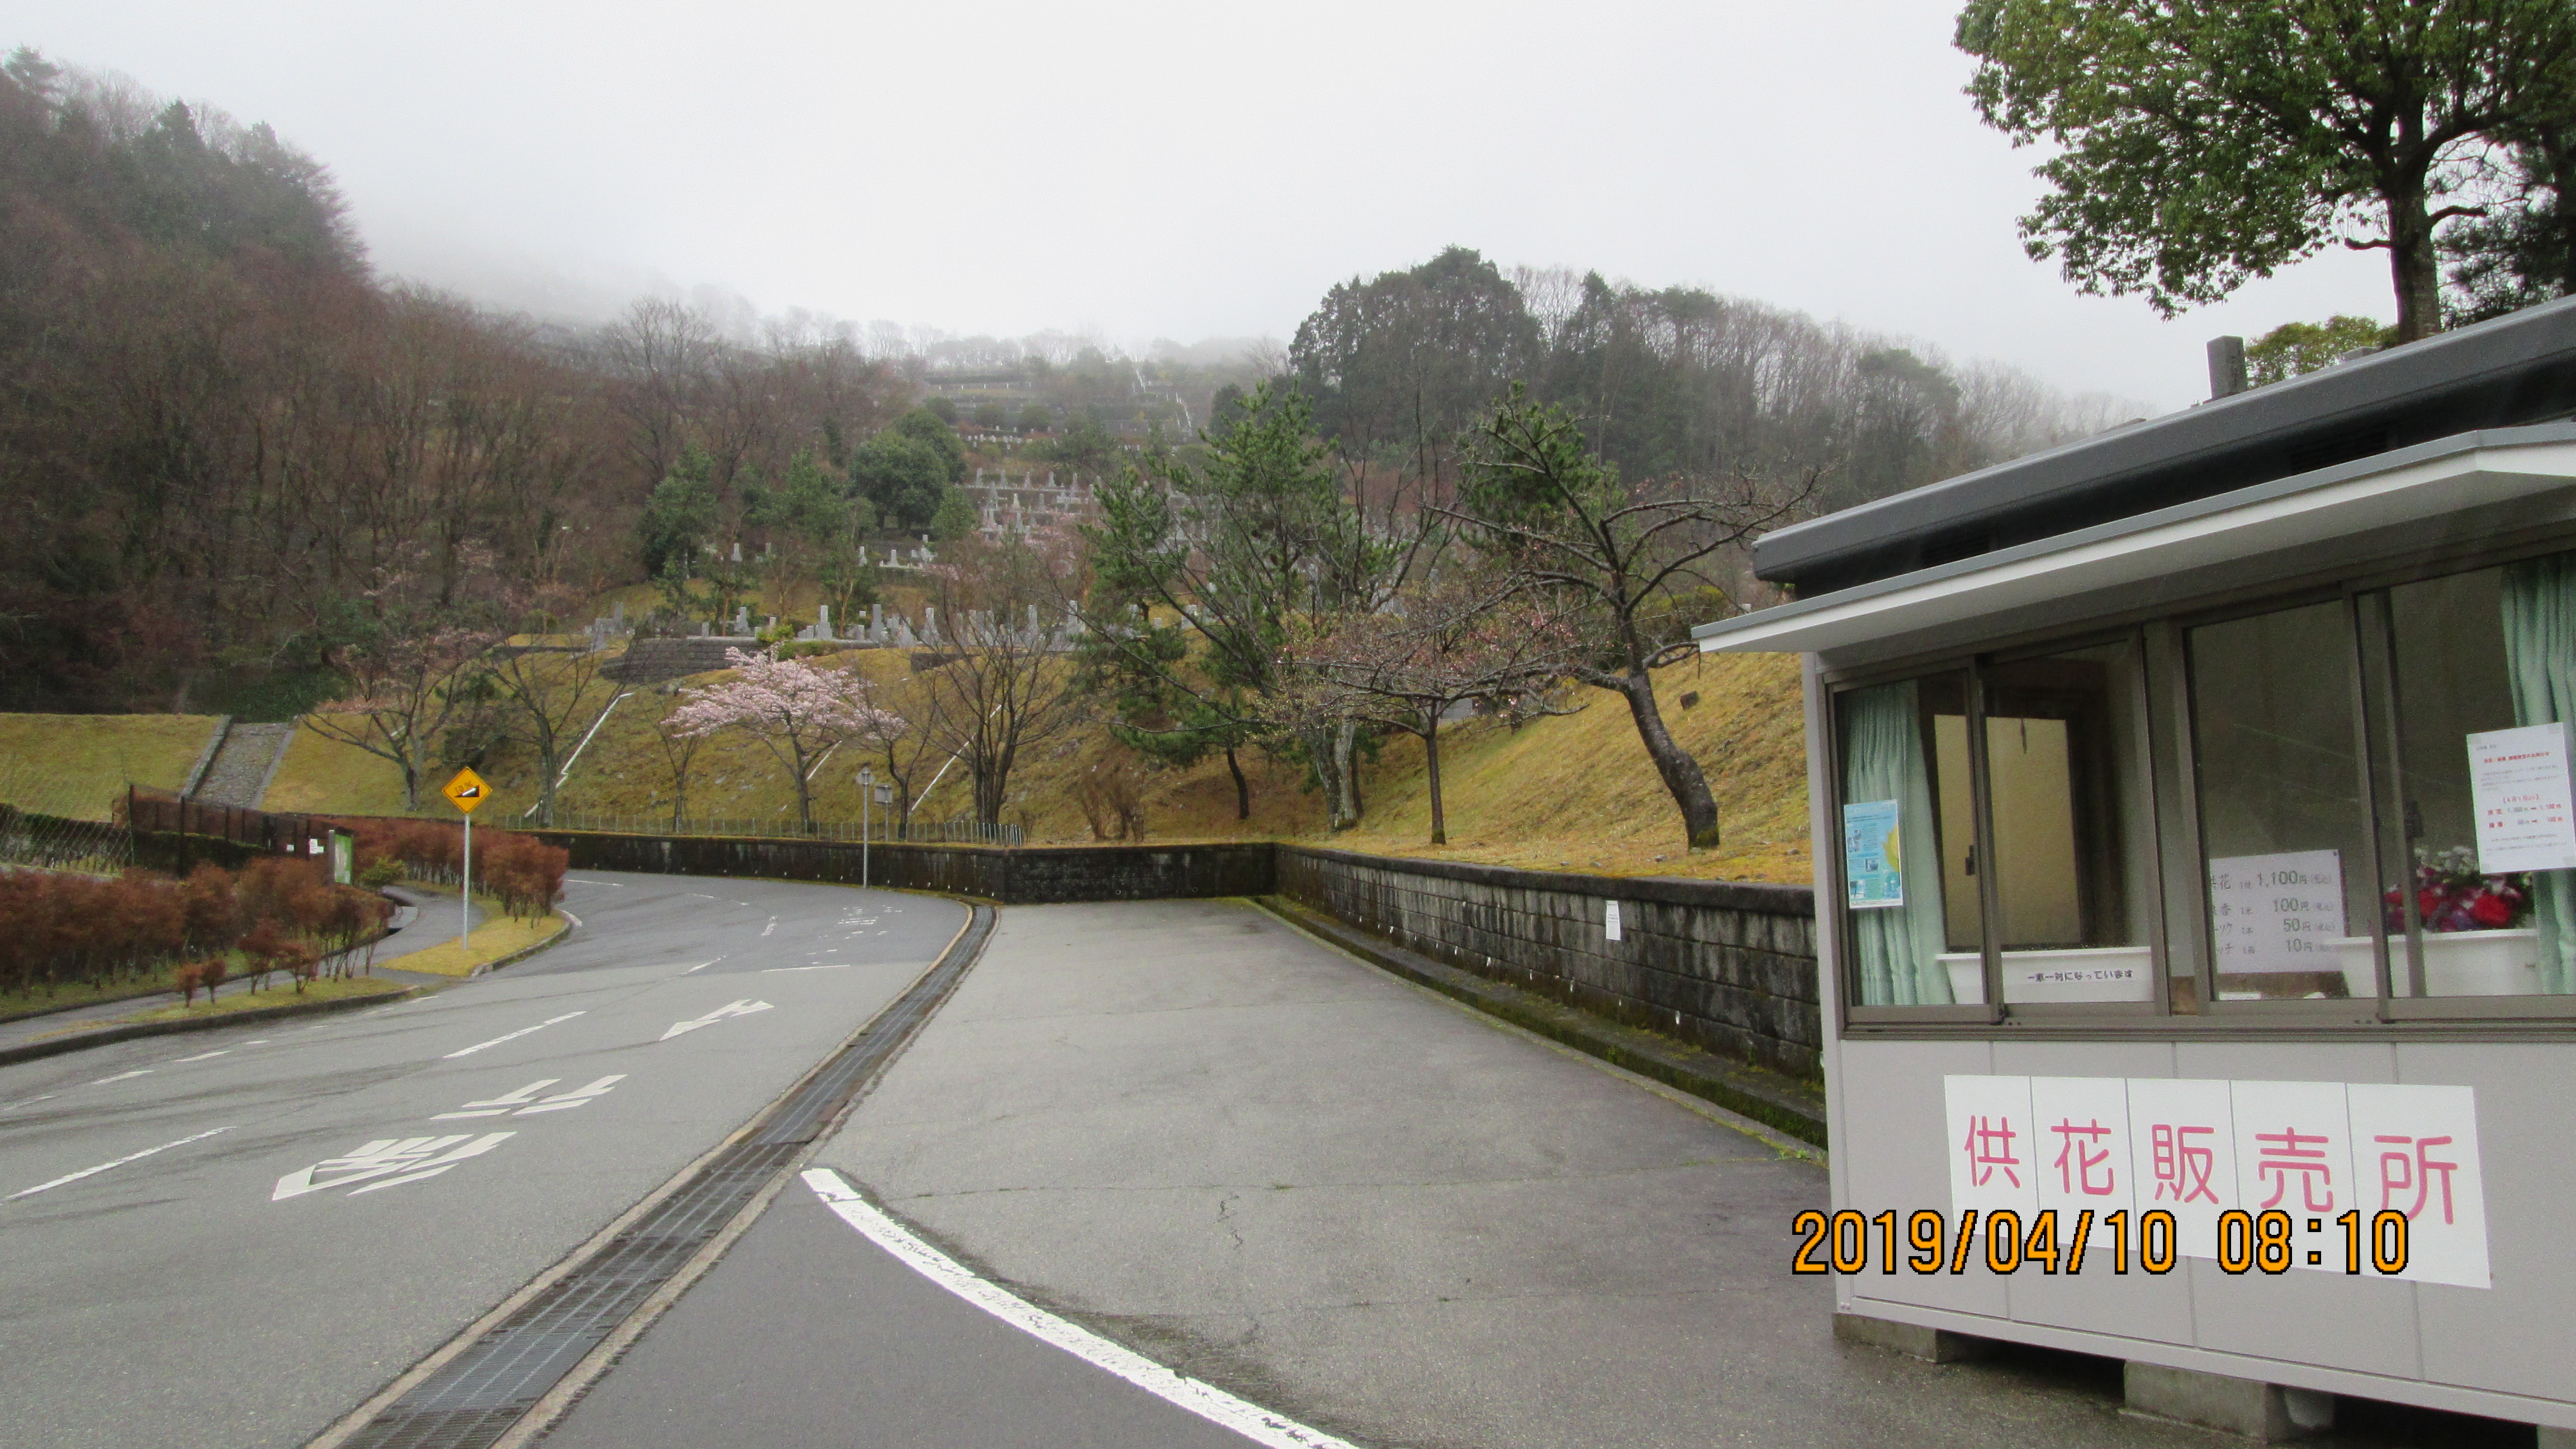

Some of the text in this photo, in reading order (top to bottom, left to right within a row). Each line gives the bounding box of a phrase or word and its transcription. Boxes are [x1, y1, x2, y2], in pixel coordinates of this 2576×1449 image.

[454, 780, 473, 793] 10%
[2257, 870, 2307, 888] 1,100円
[2213, 903, 2232, 916] 香
[2273, 898, 2309, 912] 100円
[2283, 918, 2310, 932] 50円
[2286, 938, 2312, 953] 10円
[1965, 1115, 2458, 1226] 供花販売所
